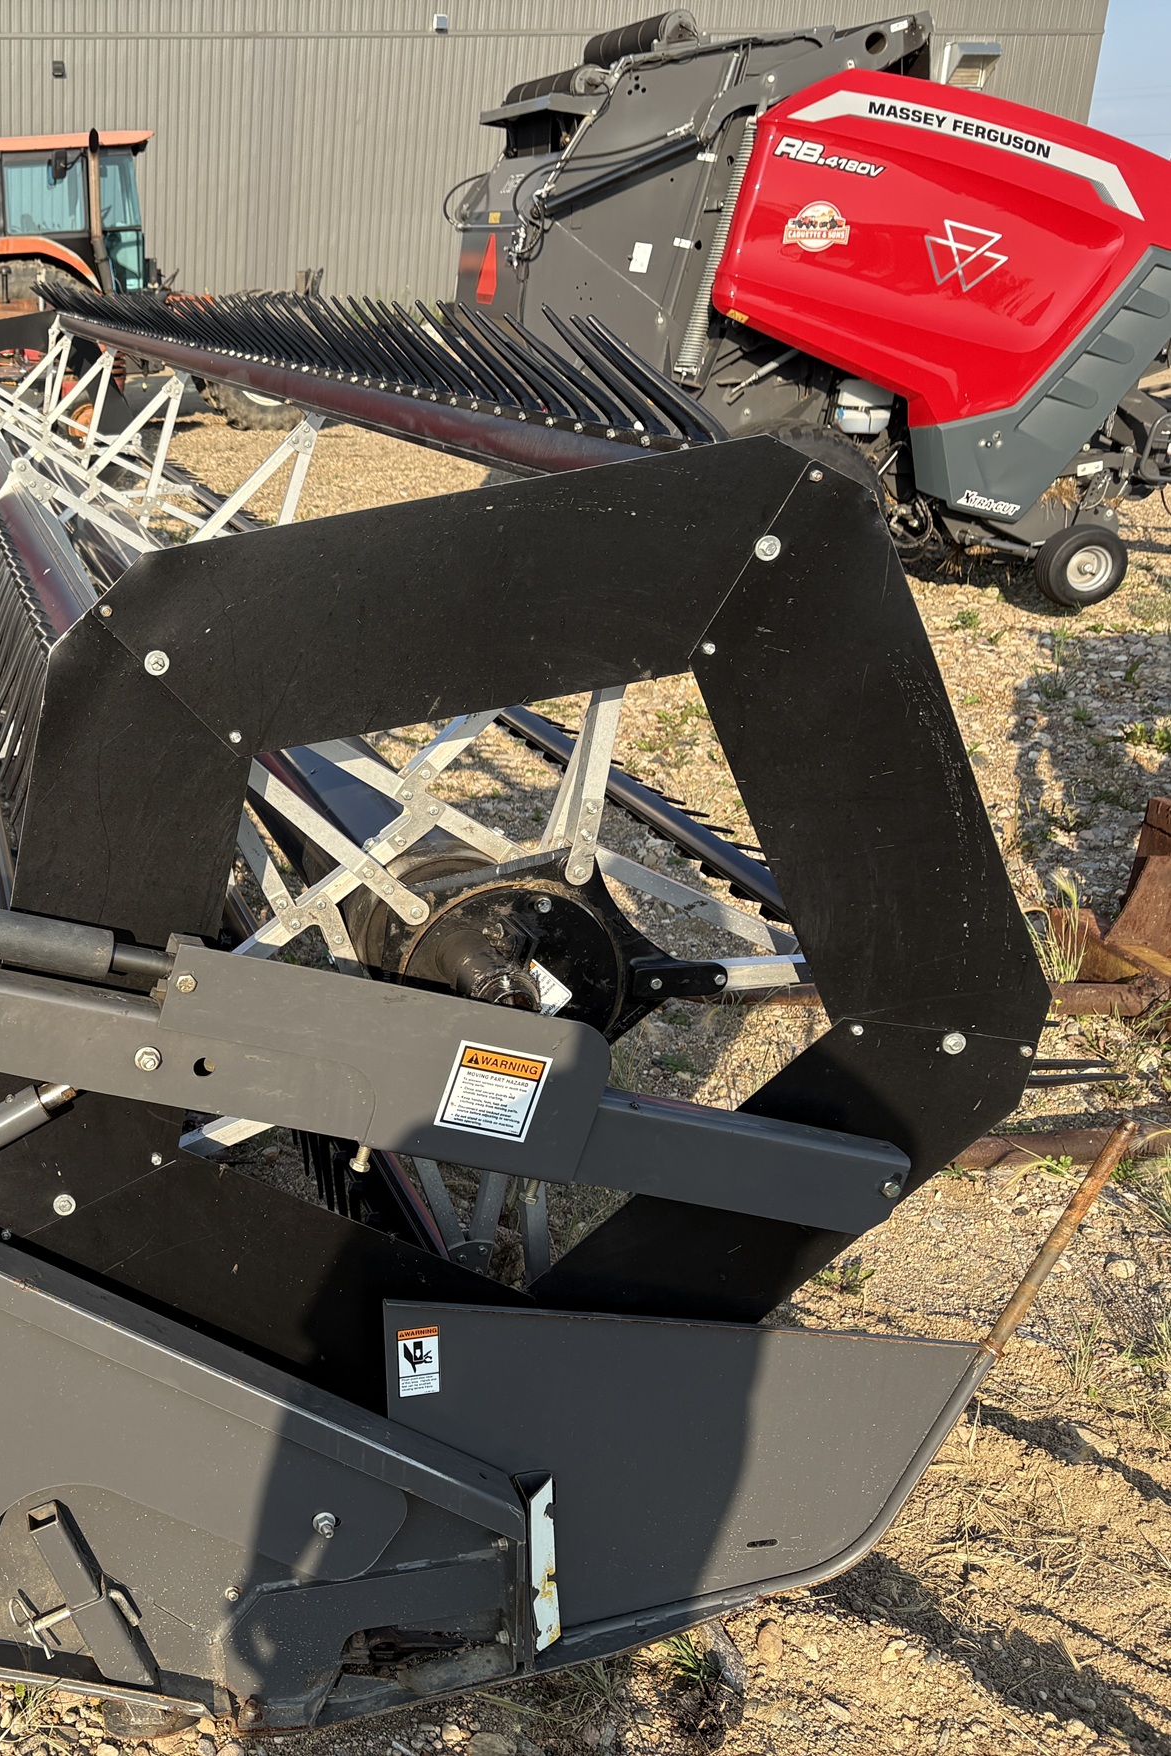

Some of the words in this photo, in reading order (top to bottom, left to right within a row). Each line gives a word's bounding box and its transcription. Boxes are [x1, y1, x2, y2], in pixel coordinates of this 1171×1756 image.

[868, 101, 947, 128] MASSEY
[952, 119, 1051, 159] FERGUSON
[481, 1056, 538, 1076] WARNING
[466, 1070, 489, 1080] MOVING
[490, 1074, 505, 1083] PART
[506, 1078, 528, 1088] HAZARD
[404, 1327, 437, 1337] WARNING
